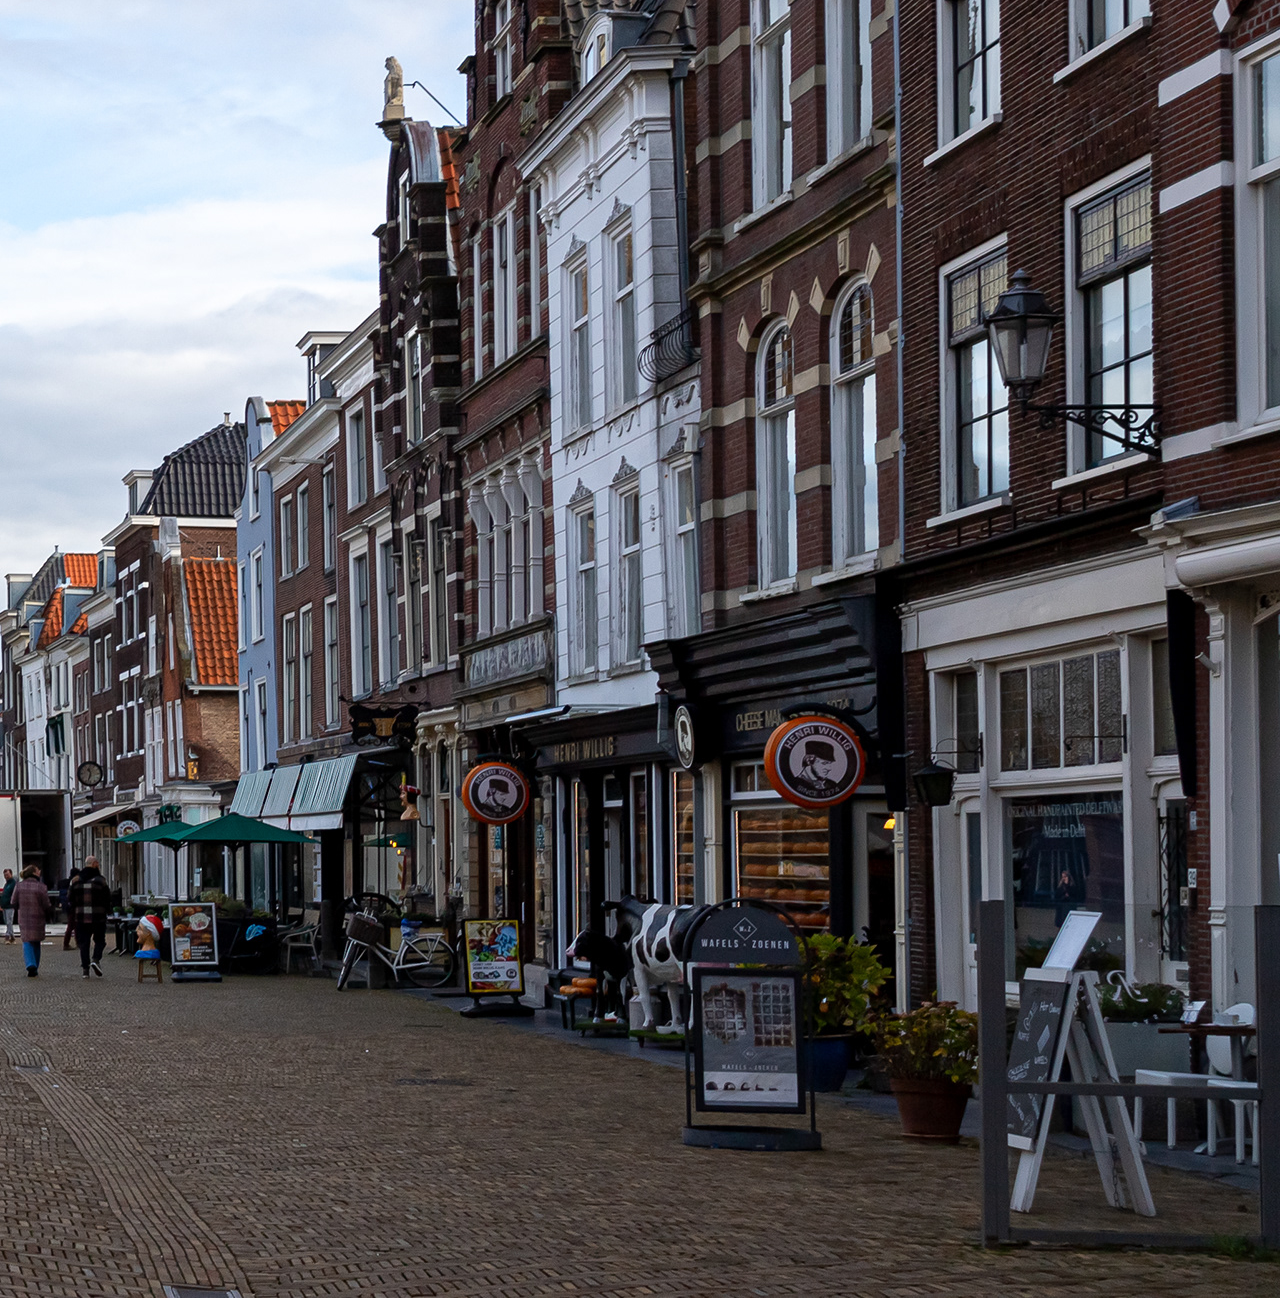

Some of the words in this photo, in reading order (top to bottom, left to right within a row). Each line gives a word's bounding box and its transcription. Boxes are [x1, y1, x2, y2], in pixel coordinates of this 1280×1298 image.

[736, 711, 764, 732] CHEESE
[784, 726, 815, 750] HENRI
[818, 726, 852, 752] WILLIG
[553, 742, 580, 762] HENRI
[582, 736, 615, 759] WILLIG
[475, 768, 497, 785] HENRI
[498, 768, 521, 787] WILLIG
[796, 784, 818, 798] SINCE
[821, 786, 841, 798] 1974
[1044, 823, 1060, 838] Made
[701, 938, 739, 948] WAFELS
[751, 939, 790, 949] ZOENEN
